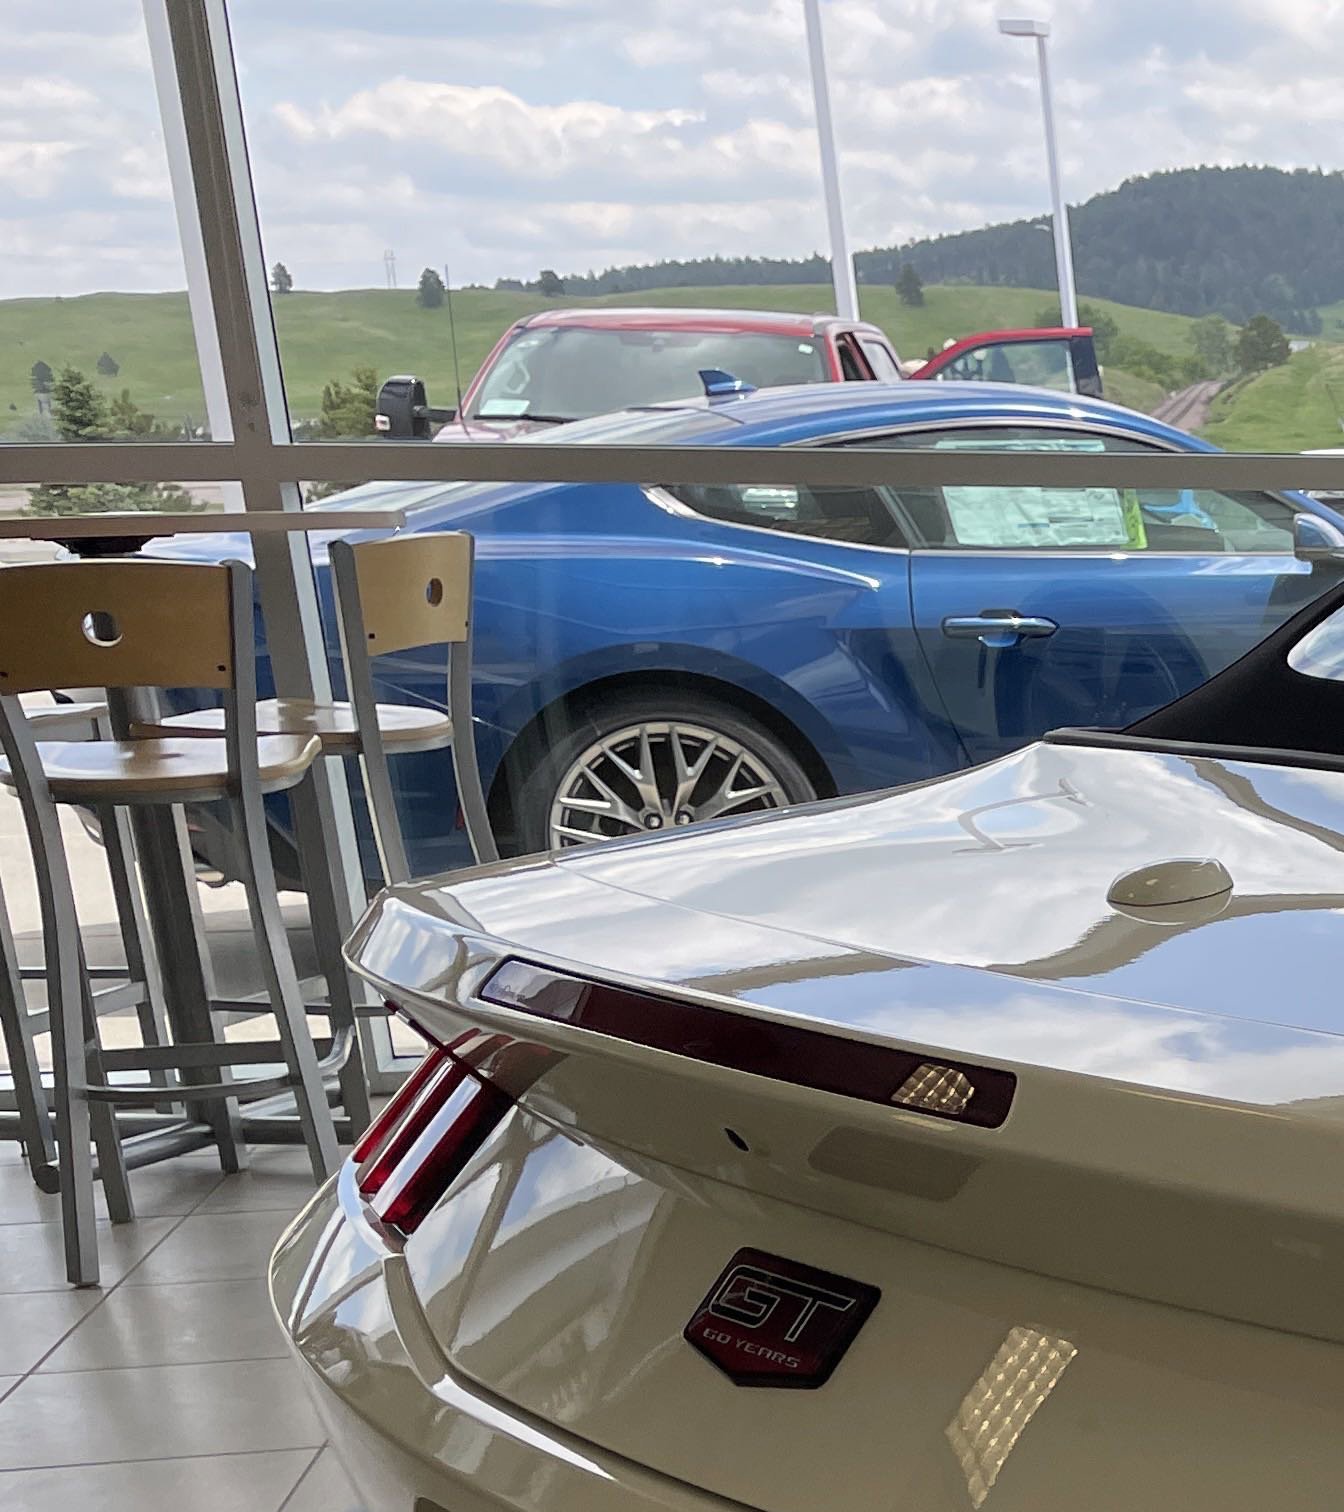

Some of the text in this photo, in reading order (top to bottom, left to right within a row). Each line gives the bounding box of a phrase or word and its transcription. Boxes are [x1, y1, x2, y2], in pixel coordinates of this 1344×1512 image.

[707, 1264, 857, 1342] GT
[702, 1326, 801, 1369] 60 YEARS
